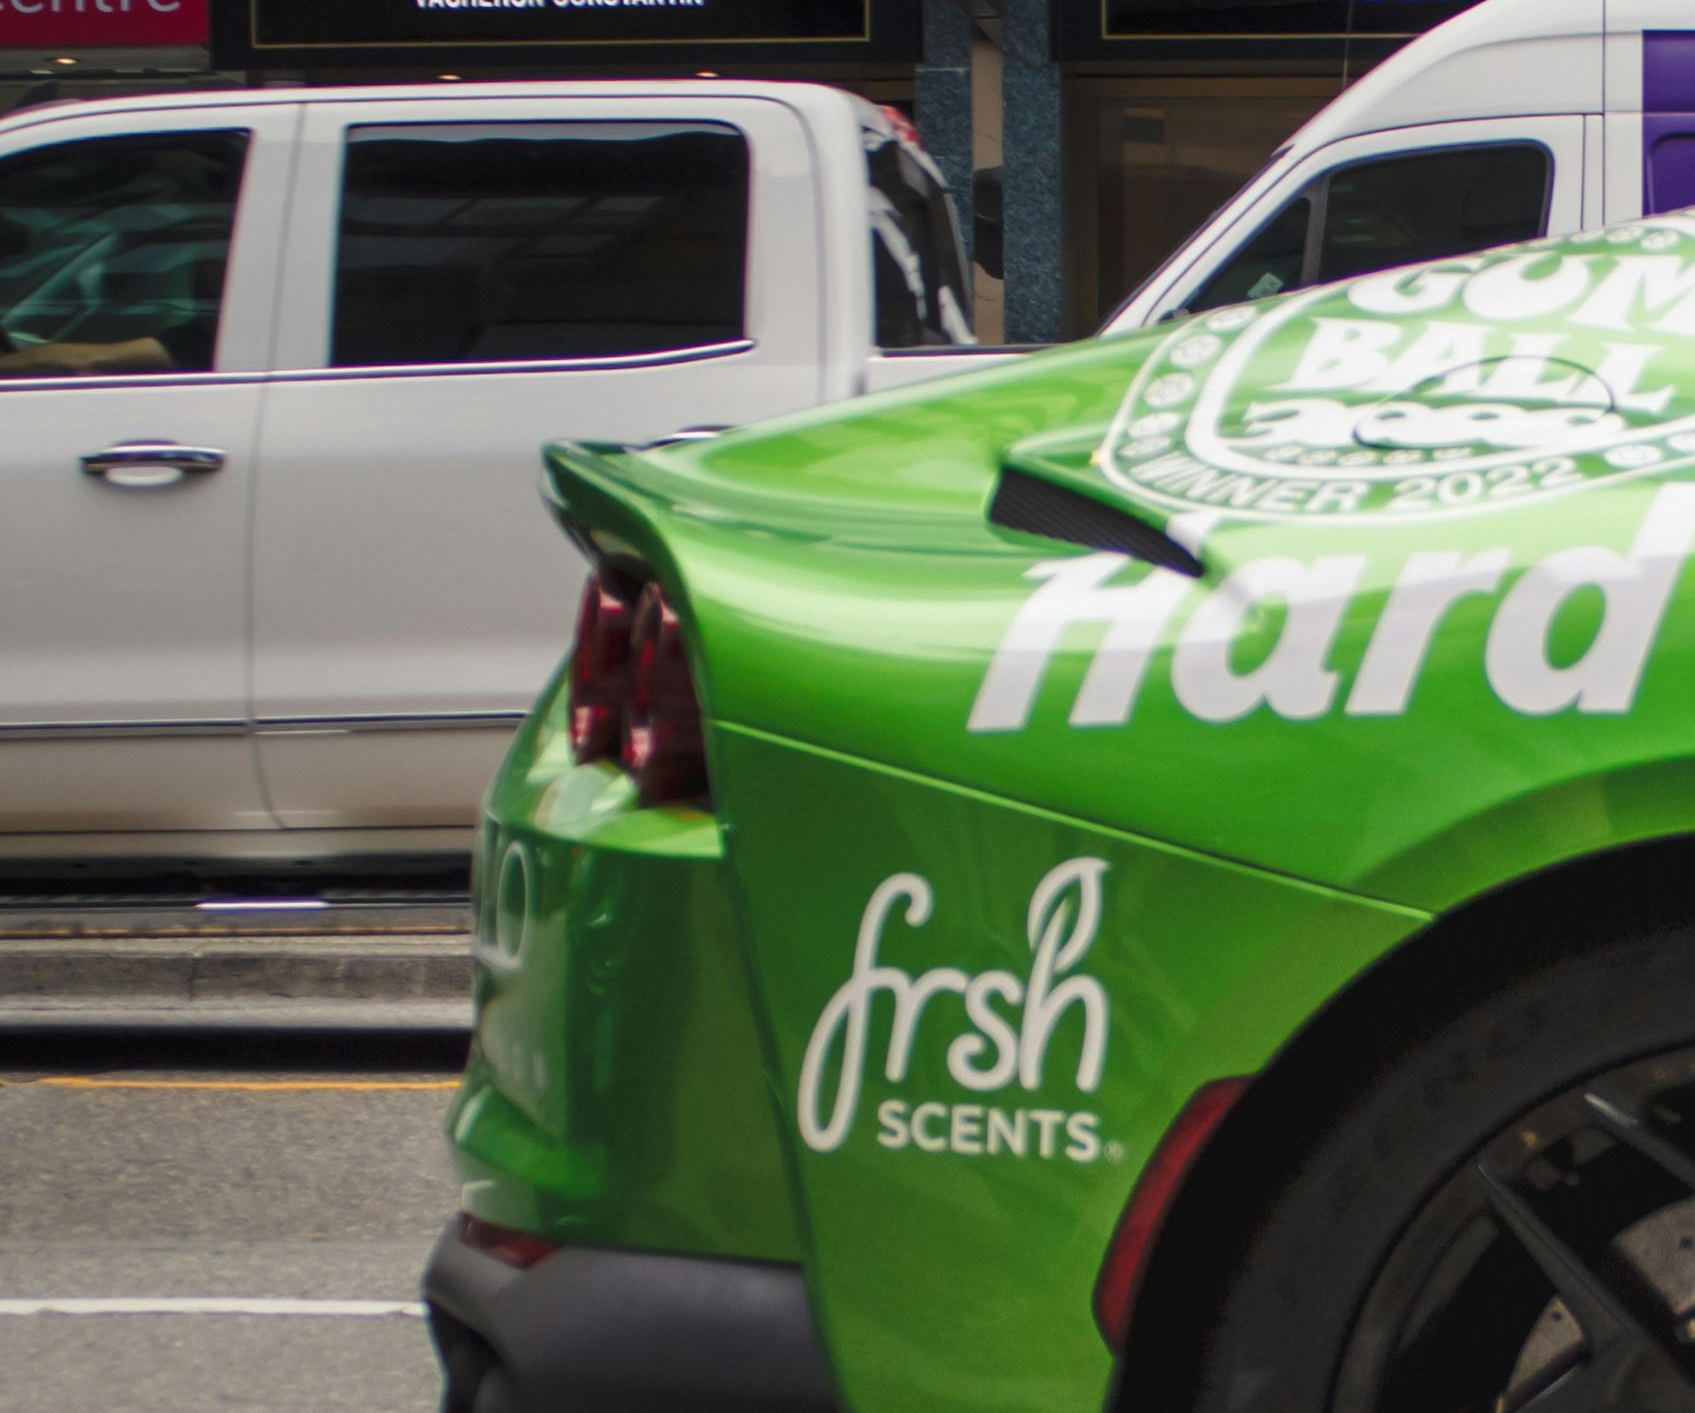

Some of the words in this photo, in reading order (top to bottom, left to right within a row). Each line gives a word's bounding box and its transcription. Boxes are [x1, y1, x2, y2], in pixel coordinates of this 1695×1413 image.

[1266, 316, 1676, 414] BALL
[1242, 398, 1628, 448] 3000
[1128, 452, 1368, 513] WINNER
[1386, 458, 1583, 511] 2022
[798, 856, 1110, 1152] frsh
[877, 1100, 1099, 1163] SCENTS
